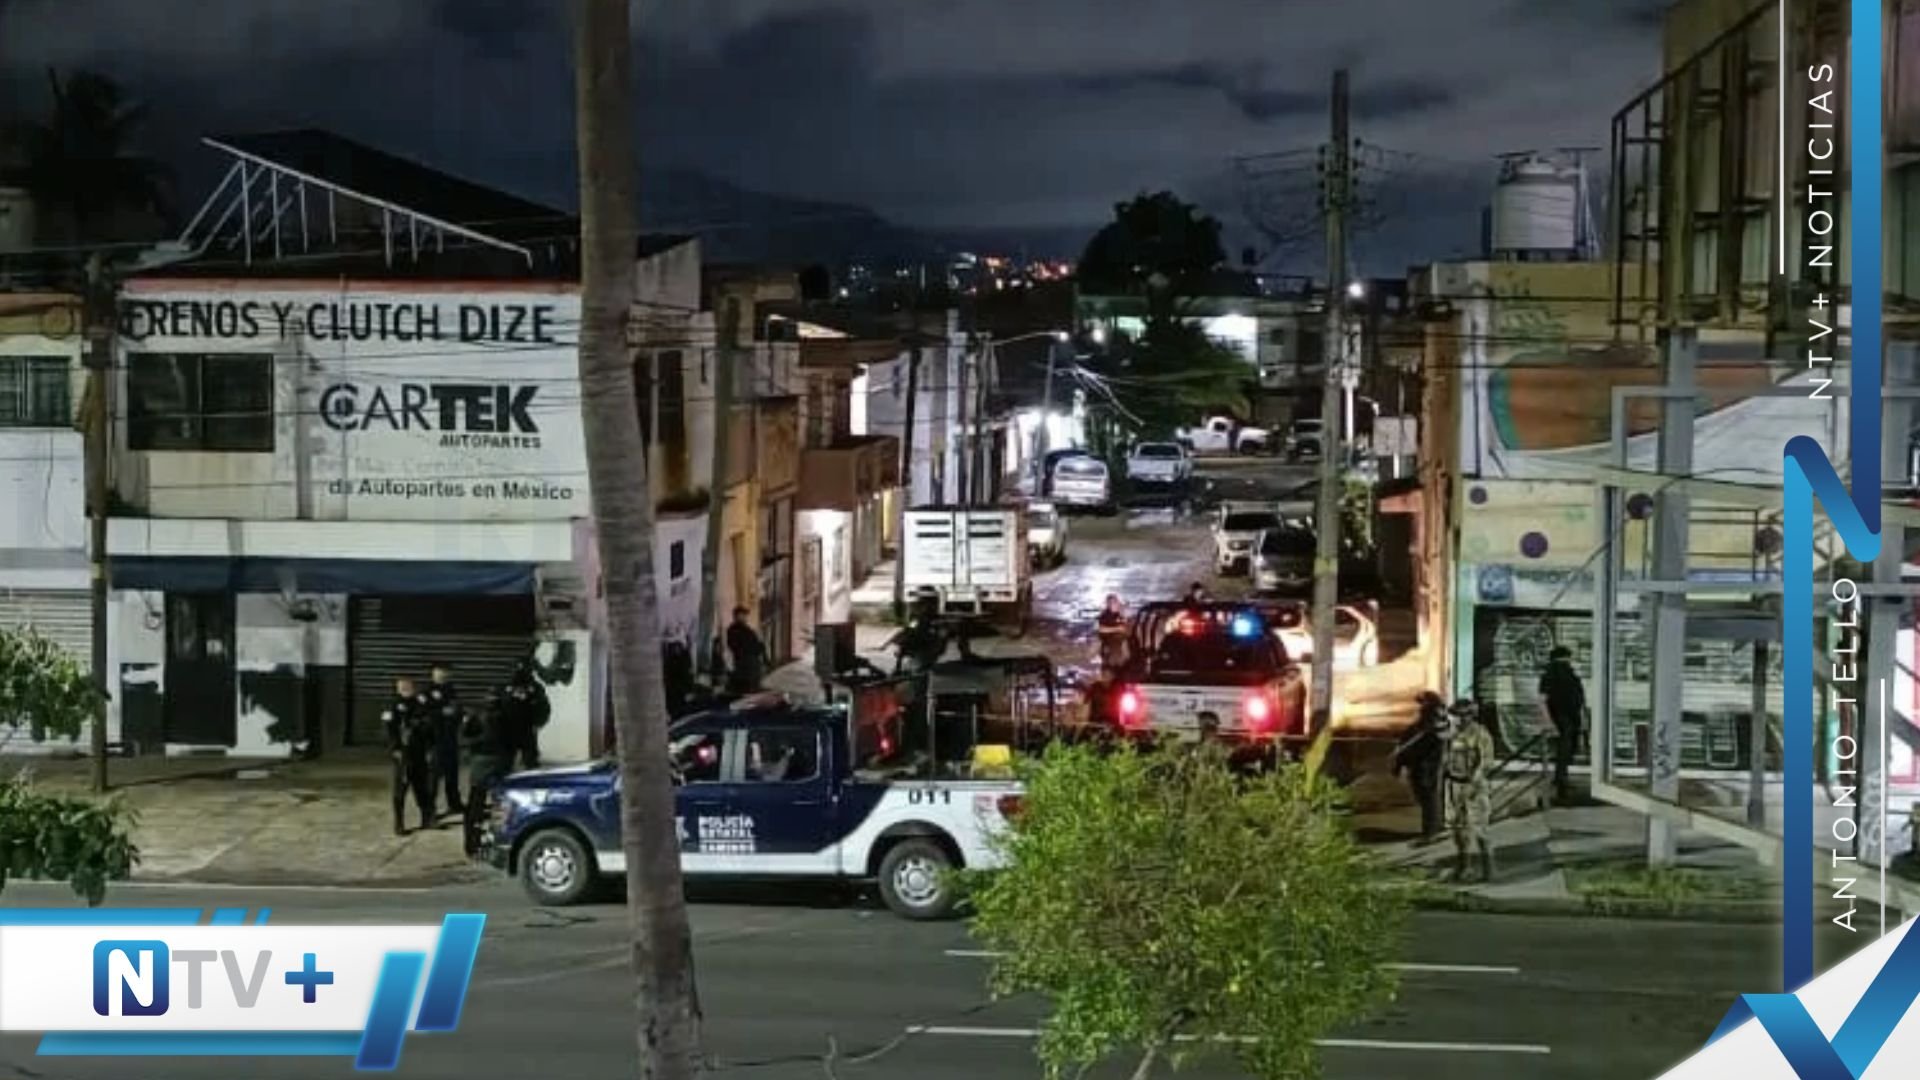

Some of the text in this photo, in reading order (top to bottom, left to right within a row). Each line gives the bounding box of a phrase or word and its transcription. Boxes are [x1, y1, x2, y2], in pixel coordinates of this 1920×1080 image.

[271, 301, 294, 340] Y
[306, 303, 439, 341] CLUTCH
[459, 304, 557, 343] DIZE
[319, 383, 540, 433] CARTEK
[439, 435, 542, 449] AUTOPARTES
[358, 478, 466, 499] Autopartes
[472, 483, 496, 499] en
[502, 479, 574, 501] México
[908, 787, 951, 805] 011
